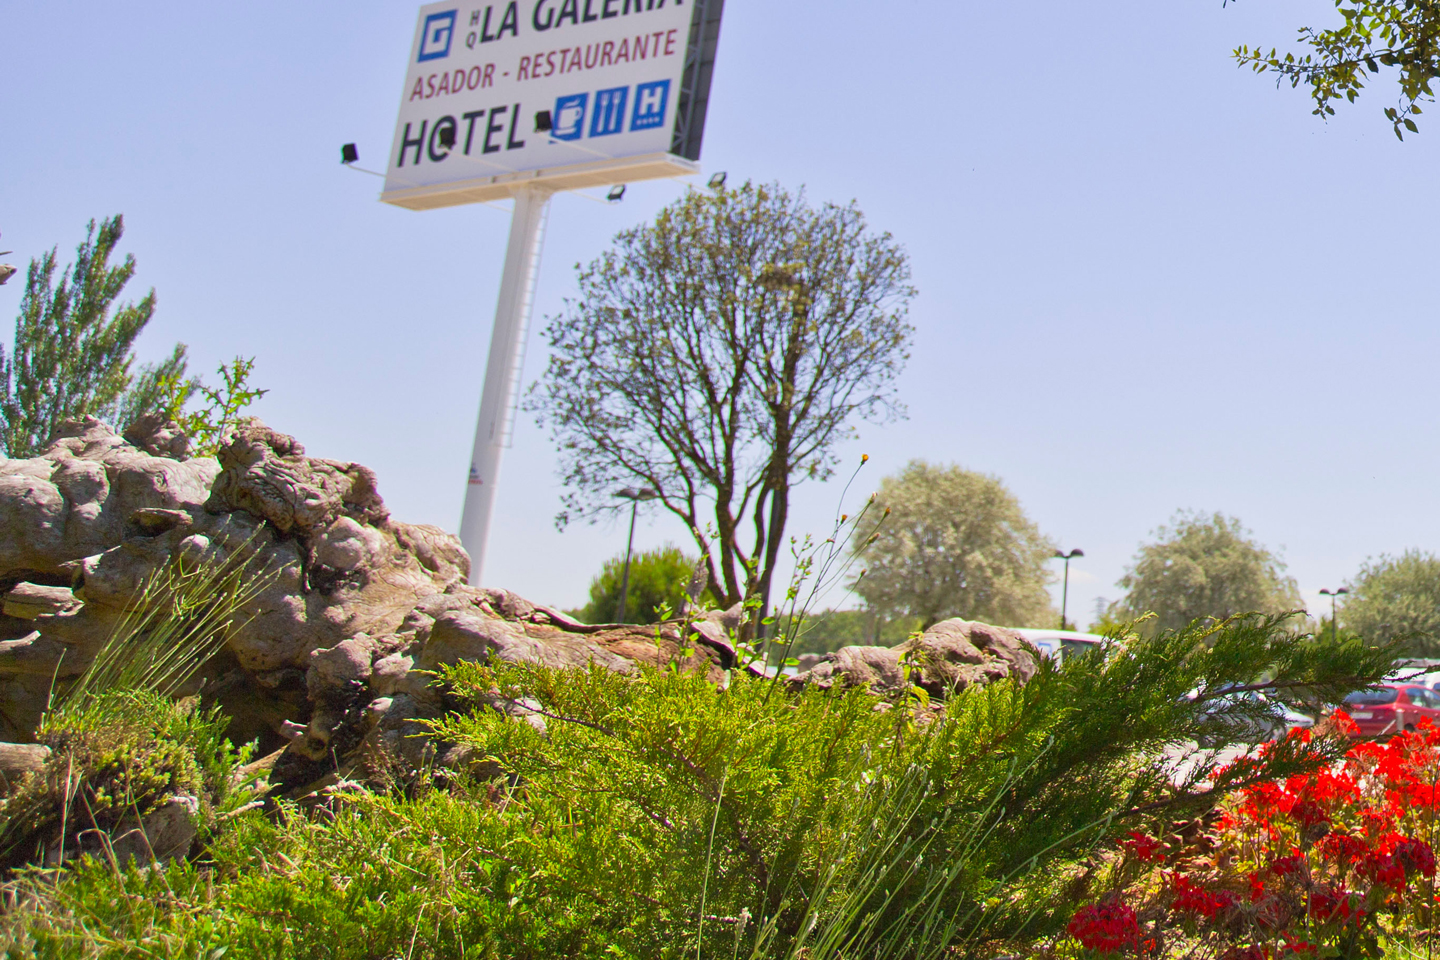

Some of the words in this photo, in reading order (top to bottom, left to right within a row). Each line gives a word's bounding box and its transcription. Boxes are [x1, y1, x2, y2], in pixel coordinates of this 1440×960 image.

[479, 0, 519, 44] LA
[409, 63, 496, 102] ASADOR
[516, 29, 678, 82] RESTAURANTE
[396, 102, 527, 168] HOTEL
